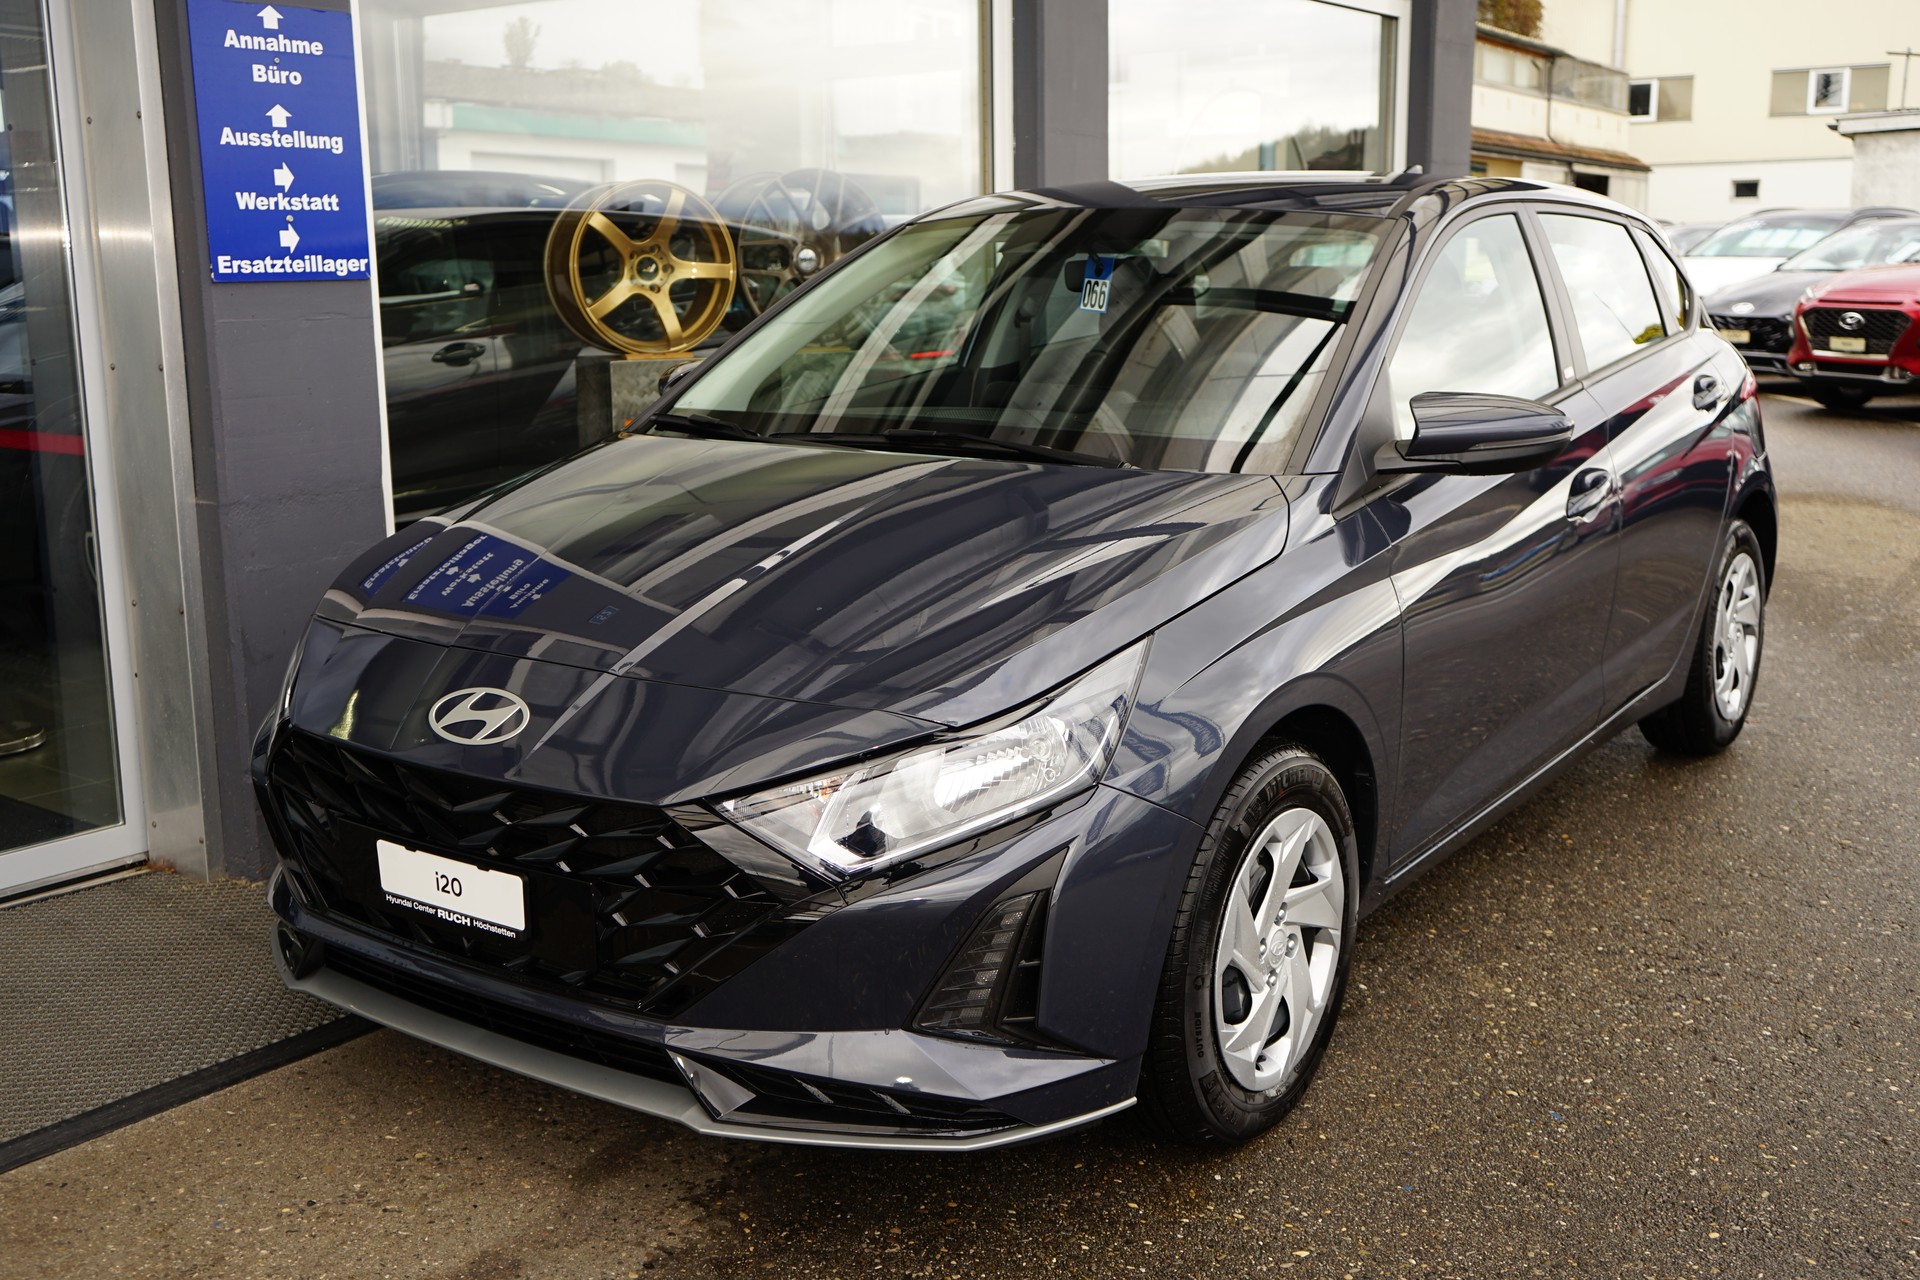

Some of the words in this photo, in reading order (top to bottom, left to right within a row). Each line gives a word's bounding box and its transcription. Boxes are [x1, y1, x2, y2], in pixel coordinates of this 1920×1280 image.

[224, 29, 323, 56] Annahme
[252, 63, 302, 85] Büro
[219, 127, 343, 154] Ausstellung
[235, 191, 340, 212] Werkstatt
[217, 255, 369, 276] Ersatzteillager
[1082, 279, 1107, 310] 066
[434, 871, 463, 898] i20
[386, 894, 412, 908] Hyundai
[413, 902, 437, 915] Center
[437, 908, 471, 927] RUCH
[473, 920, 516, 939] Höchstetten
